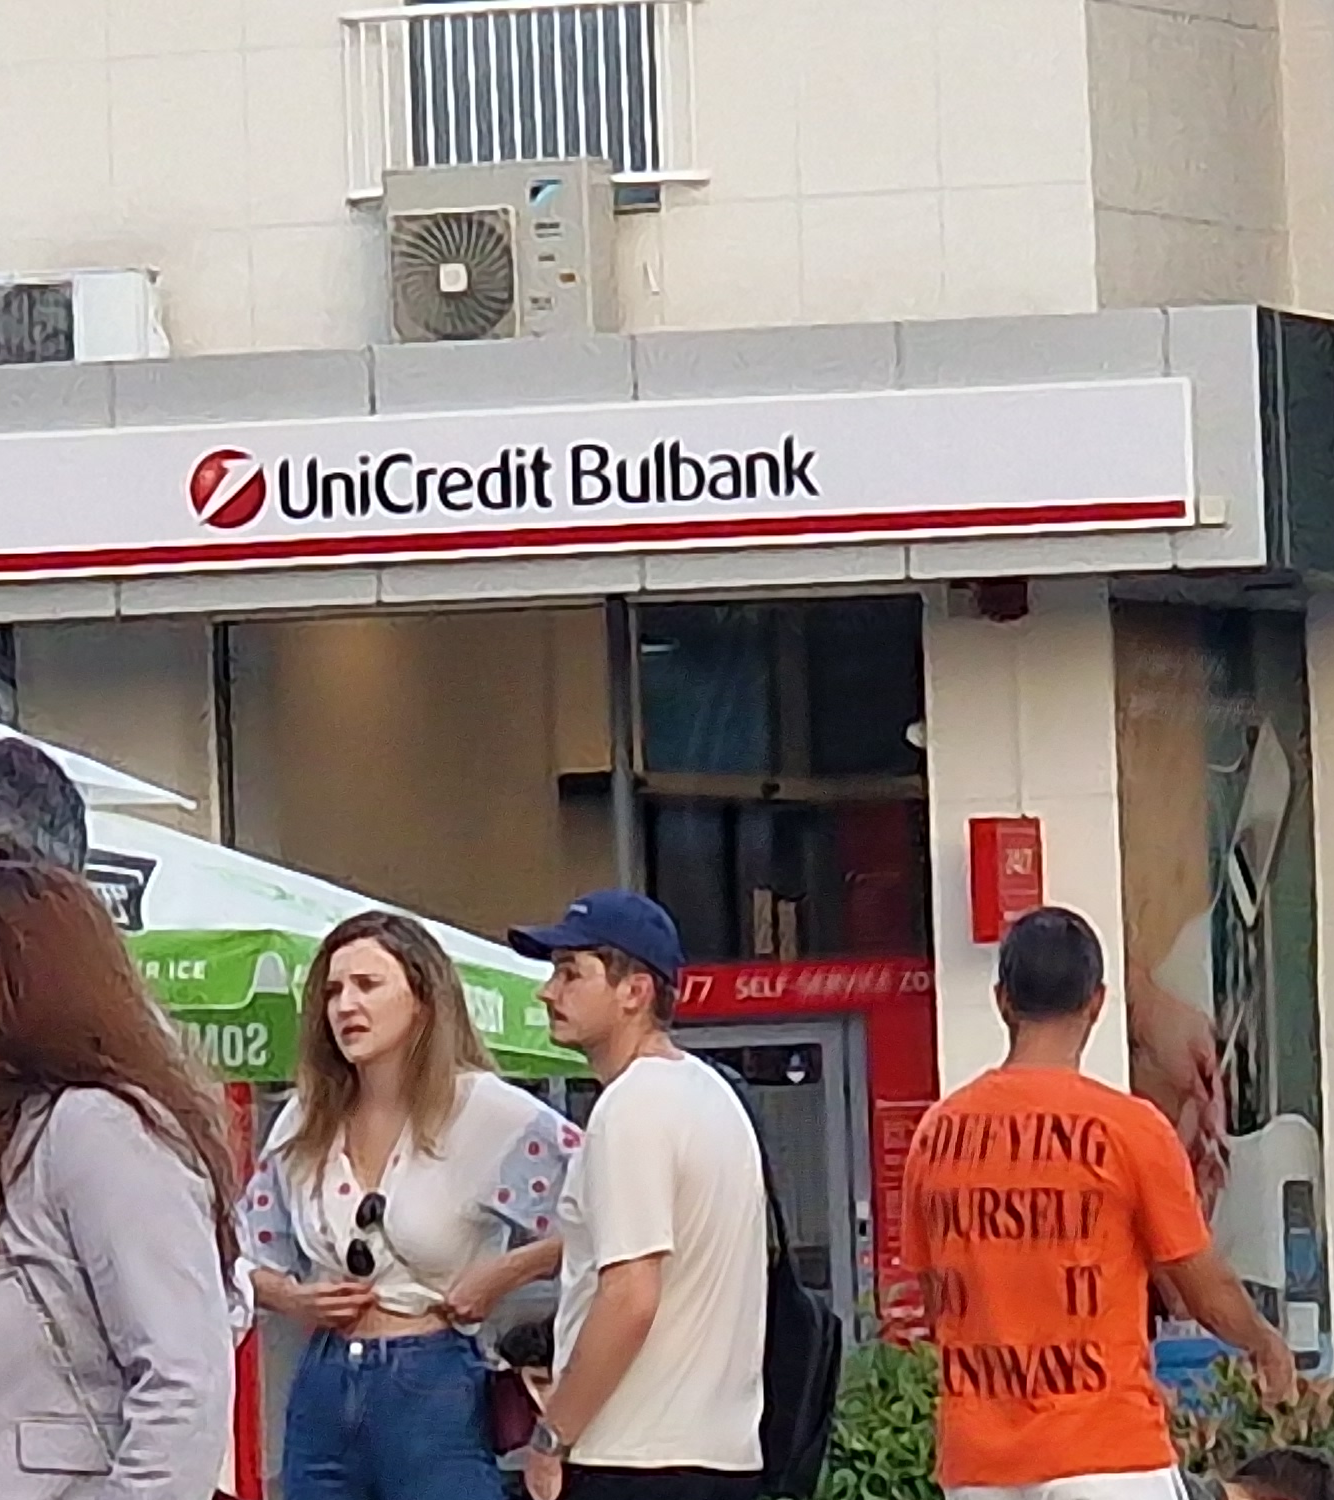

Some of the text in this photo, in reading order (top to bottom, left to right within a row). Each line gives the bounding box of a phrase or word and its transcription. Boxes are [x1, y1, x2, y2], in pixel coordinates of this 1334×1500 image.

[277, 435, 820, 519] UniCredit Bulbank
[927, 1186, 1104, 1240] OURSELF
[1060, 1264, 1102, 1318] IT
[942, 1340, 1108, 1399] NYWAYS
